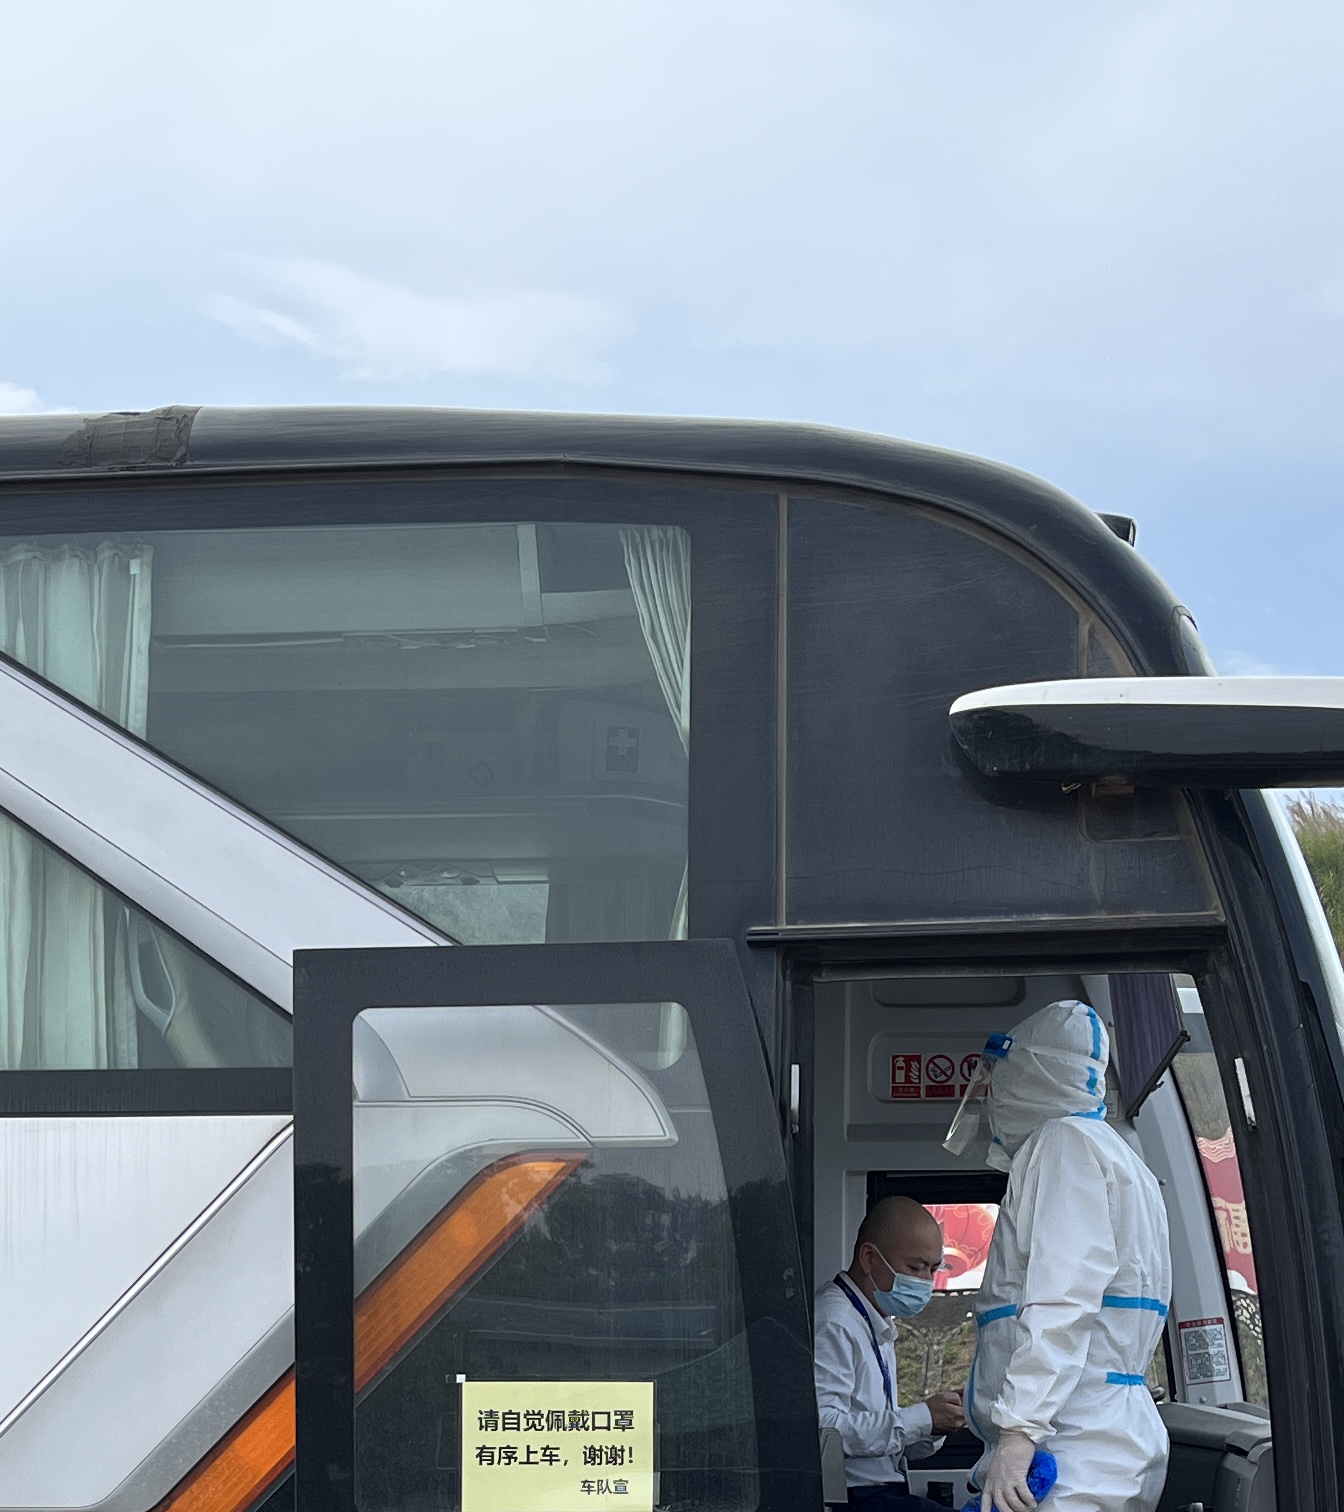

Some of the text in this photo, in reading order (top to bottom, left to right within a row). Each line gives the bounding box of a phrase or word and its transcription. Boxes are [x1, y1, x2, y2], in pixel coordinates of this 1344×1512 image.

[477, 1409, 635, 1432] 请自觉佩戴口罩
[580, 1479, 629, 1495] 车队宣
